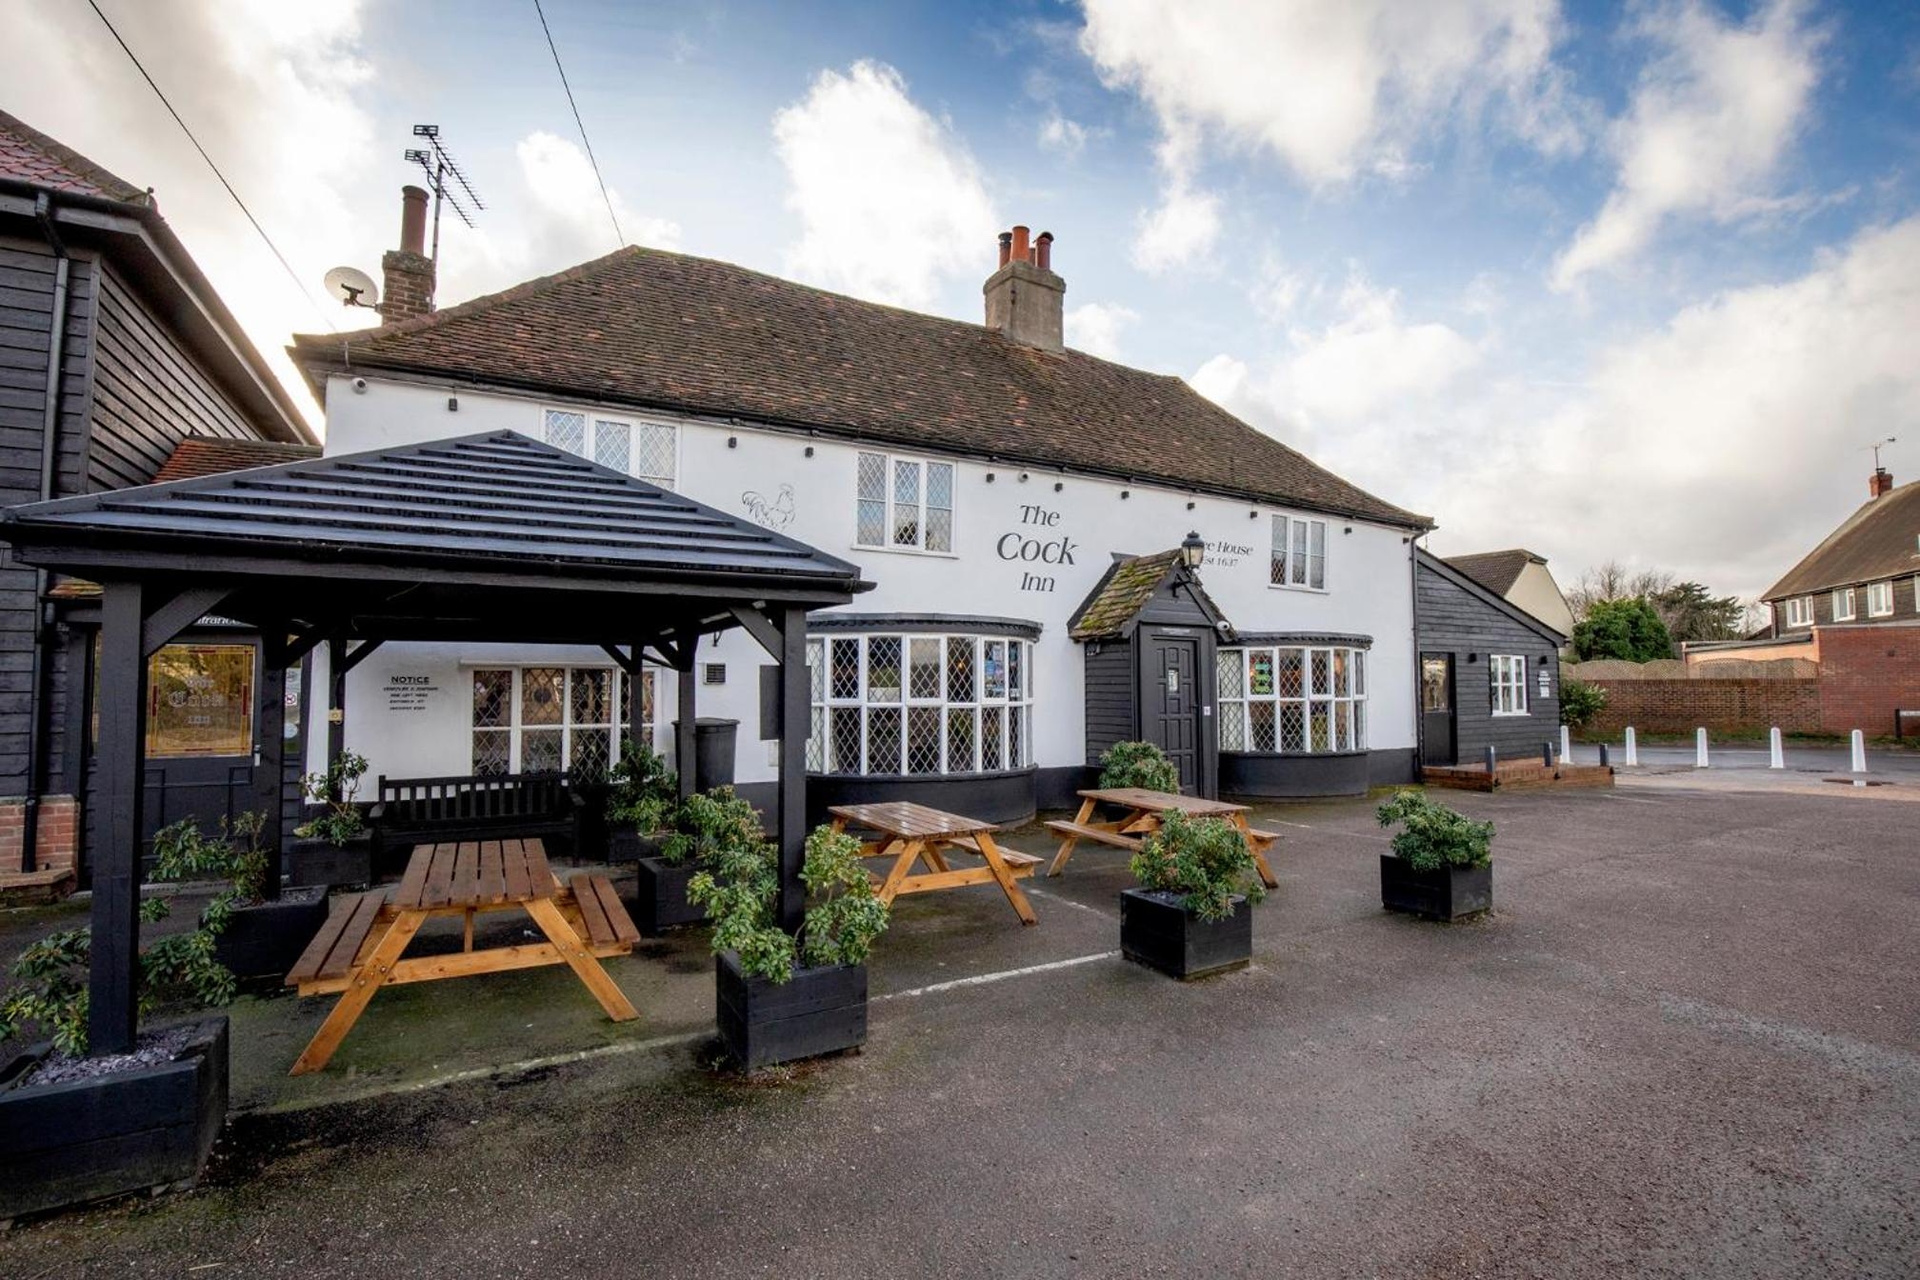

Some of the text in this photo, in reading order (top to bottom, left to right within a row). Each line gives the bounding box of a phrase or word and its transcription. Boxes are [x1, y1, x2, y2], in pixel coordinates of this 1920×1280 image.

[1020, 504, 1060, 527] The
[996, 532, 1079, 566] Cock
[1217, 541, 1254, 556] House
[1020, 572, 1056, 592] Inn
[391, 676, 430, 684] NOTICE
